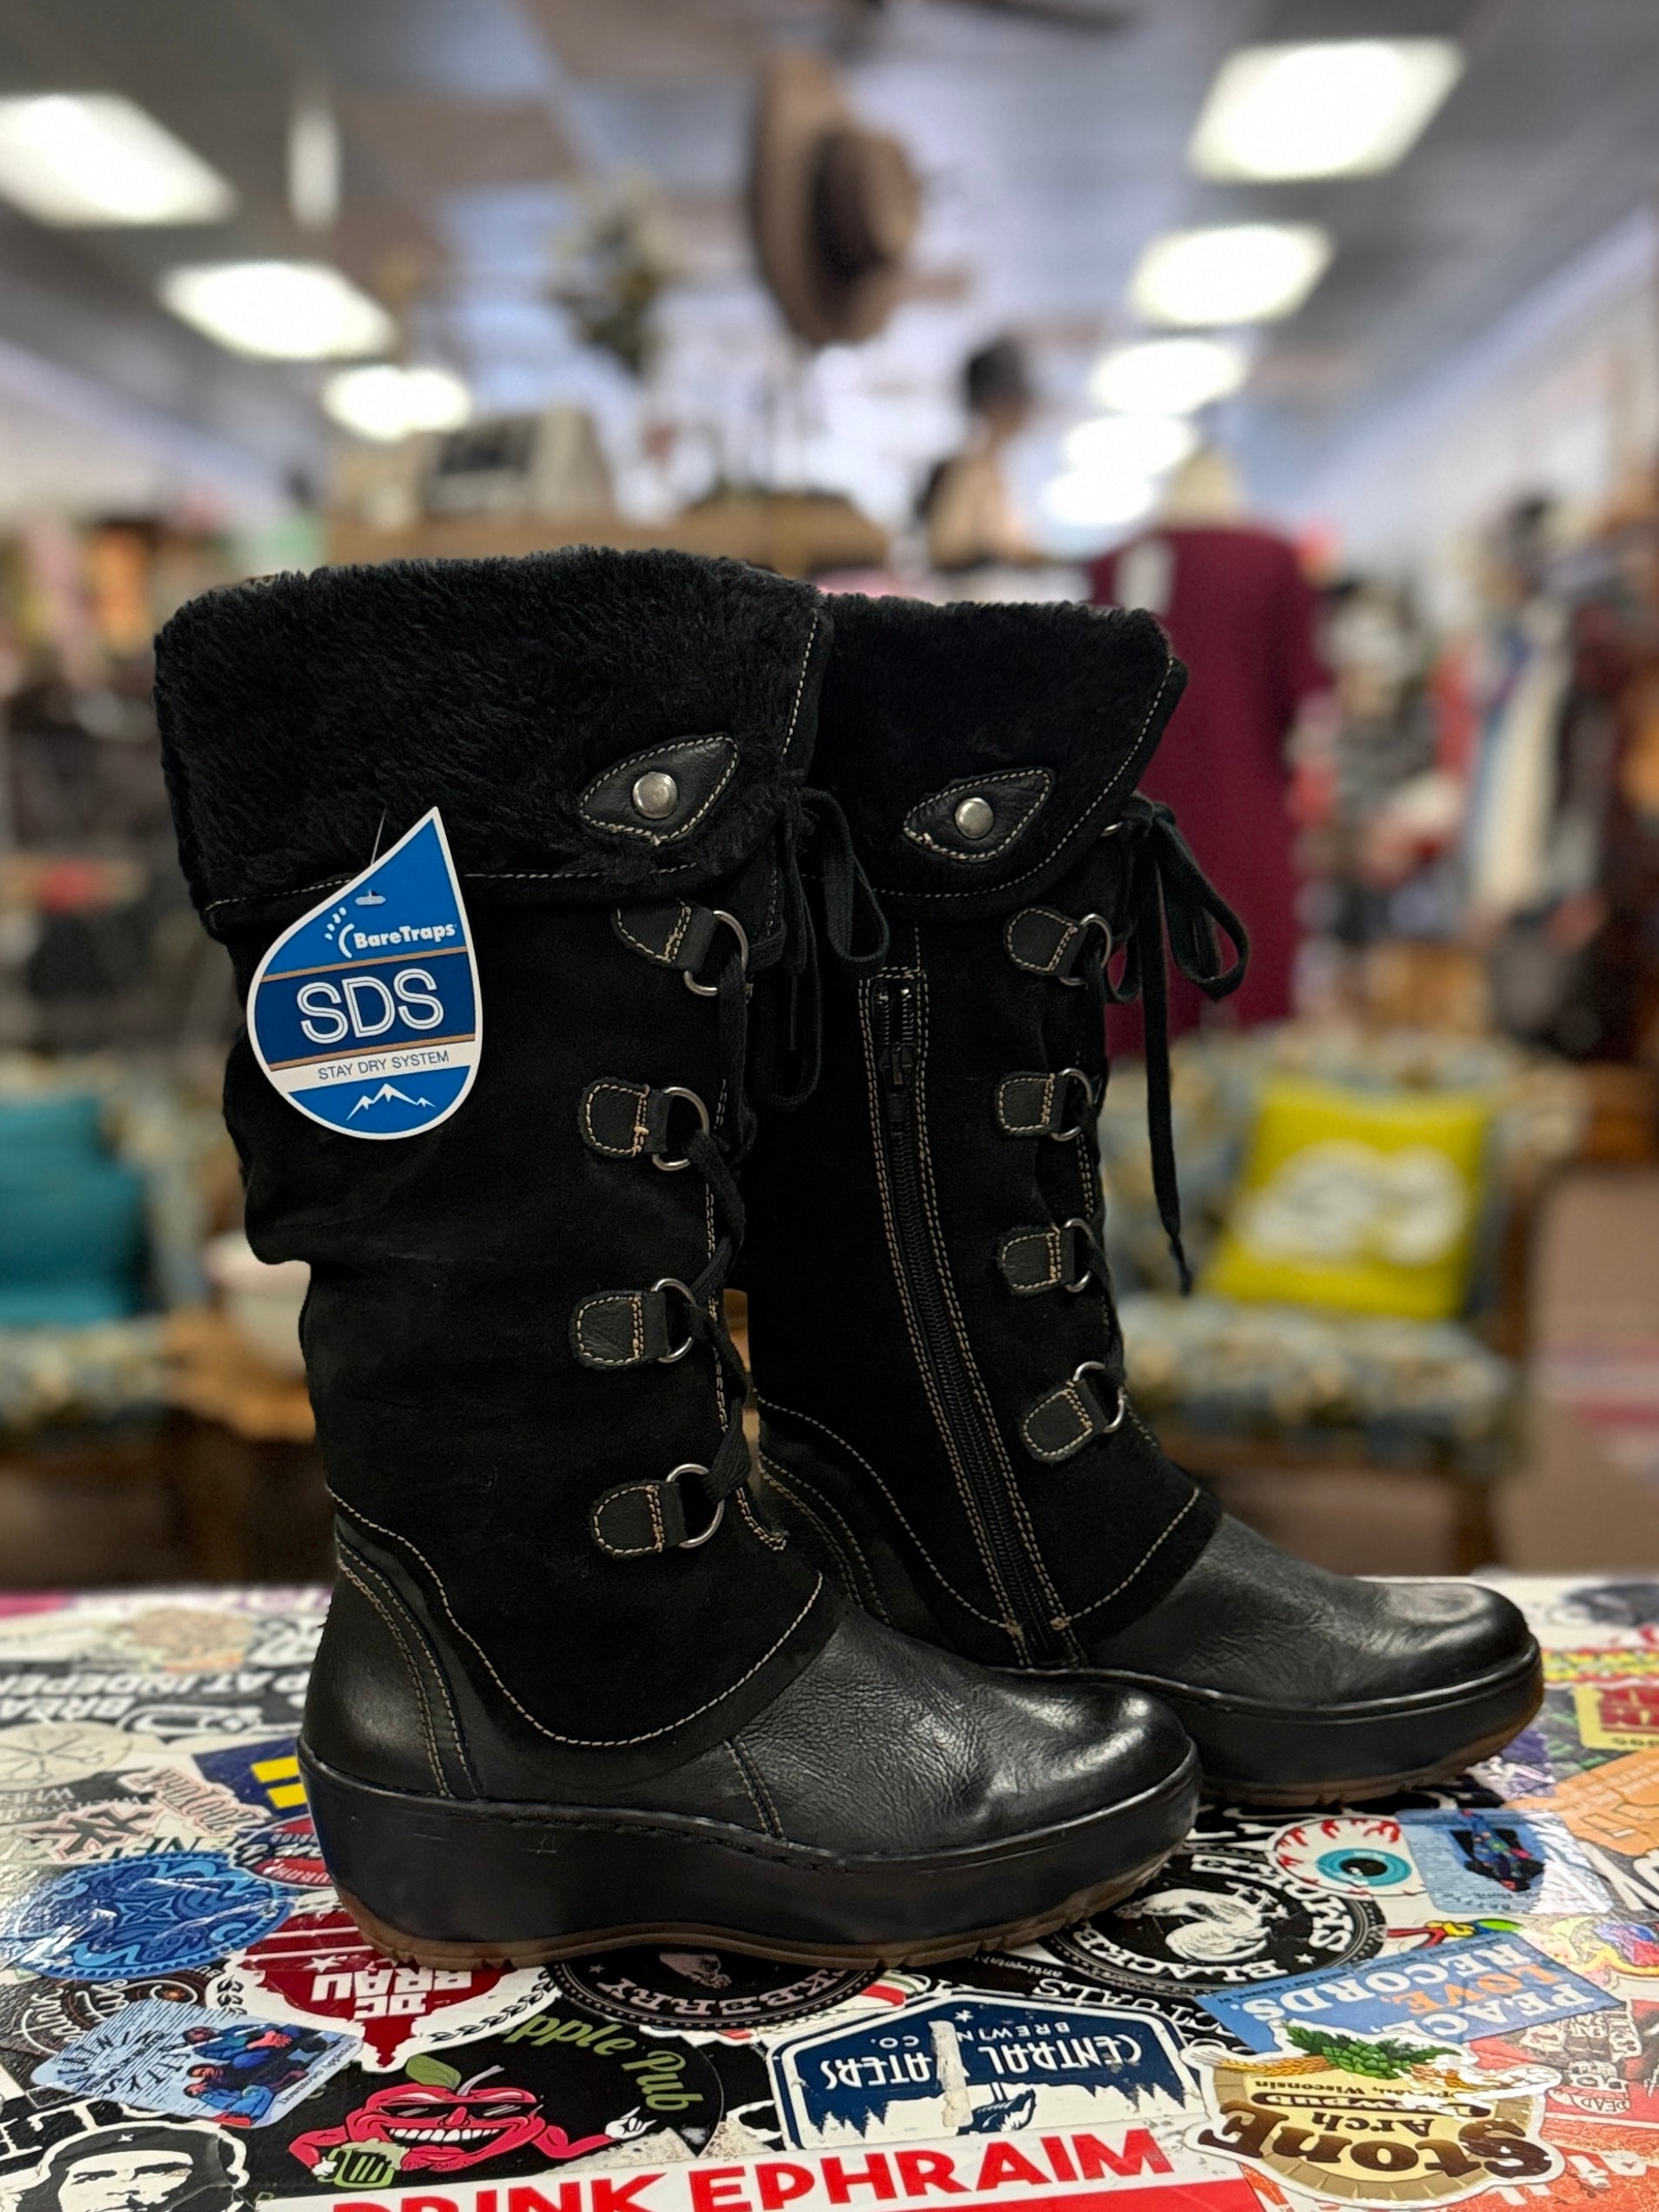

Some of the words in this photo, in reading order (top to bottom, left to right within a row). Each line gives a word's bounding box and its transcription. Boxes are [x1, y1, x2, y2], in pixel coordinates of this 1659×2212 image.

[353, 923, 456, 949] BareTraps
[296, 968, 444, 1044] SDS
[318, 1063, 353, 1081] STAY
[358, 1058, 386, 1075] DRY
[392, 1050, 450, 1069] SYSTEM
[0, 1696, 136, 1722] BREA
[1191, 1854, 1354, 1950] SMOKE
[1072, 1917, 1288, 1982] BLACKB
[311, 1967, 471, 2000] BRAU
[596, 1969, 846, 2015] KBERRY
[1230, 1944, 1530, 2021] RECORDS.
[1381, 1964, 1559, 2015] LOVE.
[355, 1992, 427, 2020] DC
[870, 2034, 920, 2049] CO.
[956, 2021, 1069, 2042] BREWIN
[500, 2015, 636, 2055] pple
[621, 2050, 704, 2110] Pub
[820, 2053, 969, 2089] ATERS
[977, 2034, 1142, 2075] CENTRAL
[1256, 2081, 1364, 2095] Wisconsin
[1580, 2096, 1626, 2112] DEAD
[1263, 2094, 1473, 2116] wpub
[1311, 2112, 1434, 2136] Arch
[688, 2129, 1173, 2212] EPHRAIM
